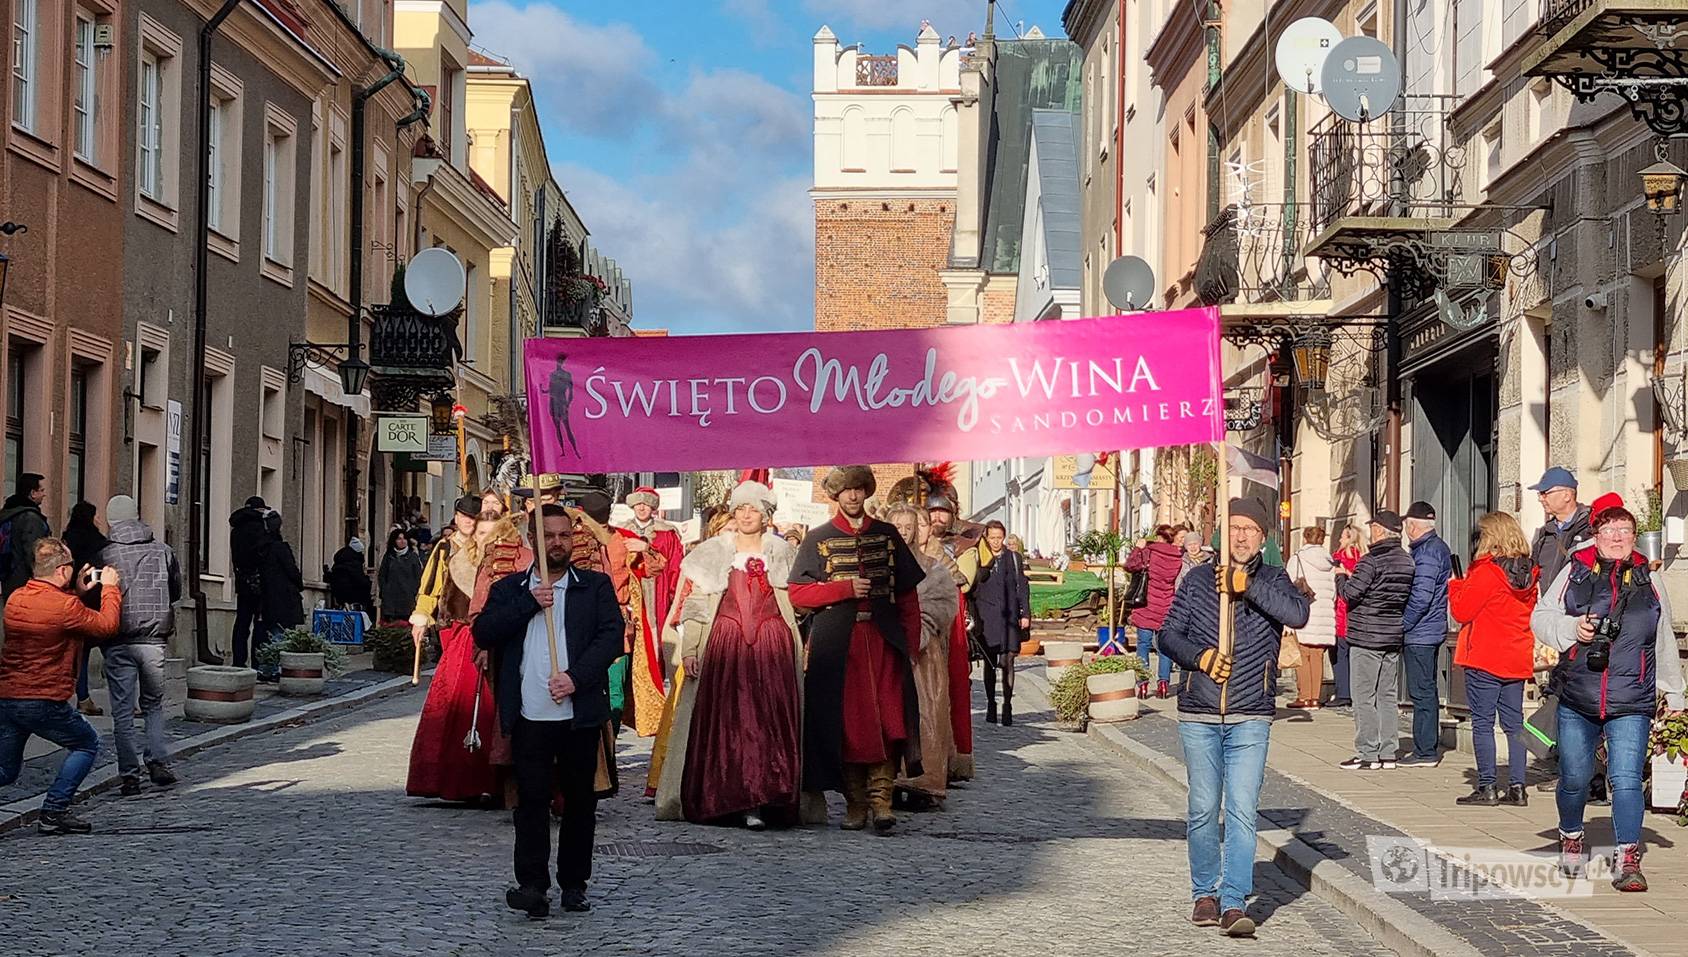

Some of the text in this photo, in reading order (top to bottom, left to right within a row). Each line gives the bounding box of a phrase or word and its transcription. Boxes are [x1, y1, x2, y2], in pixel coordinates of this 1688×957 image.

[583, 346, 1162, 432] ŚWIĘTO Młodego WINA
[388, 422, 416, 431] CARTE
[989, 397, 1217, 435] SANDOMIERZ
